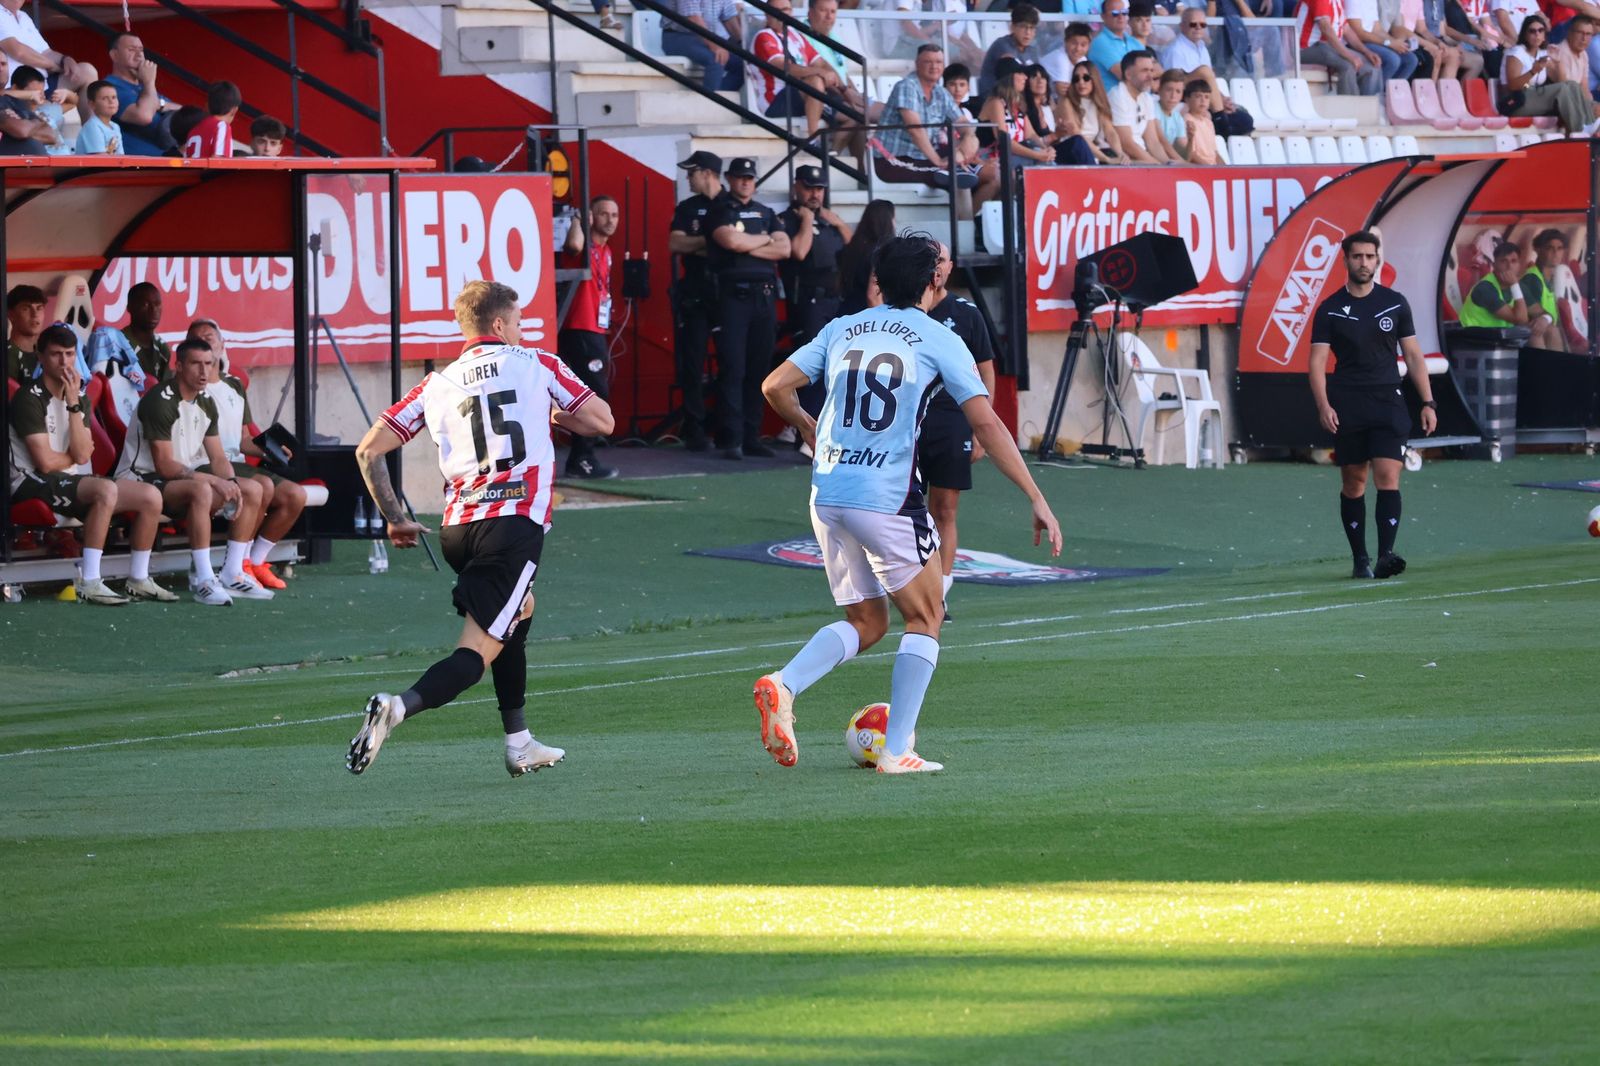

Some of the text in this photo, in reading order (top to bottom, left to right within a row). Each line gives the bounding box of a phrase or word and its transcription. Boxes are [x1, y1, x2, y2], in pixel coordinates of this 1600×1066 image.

[307, 189, 542, 315] DUERO
[1175, 176, 1333, 284] DUE
[844, 320, 923, 347] JOEL LÓPEZ
[1272, 233, 1341, 358] AMAQ
[462, 362, 499, 386] LOREN
[842, 349, 904, 432] 18
[457, 389, 527, 476] 15
